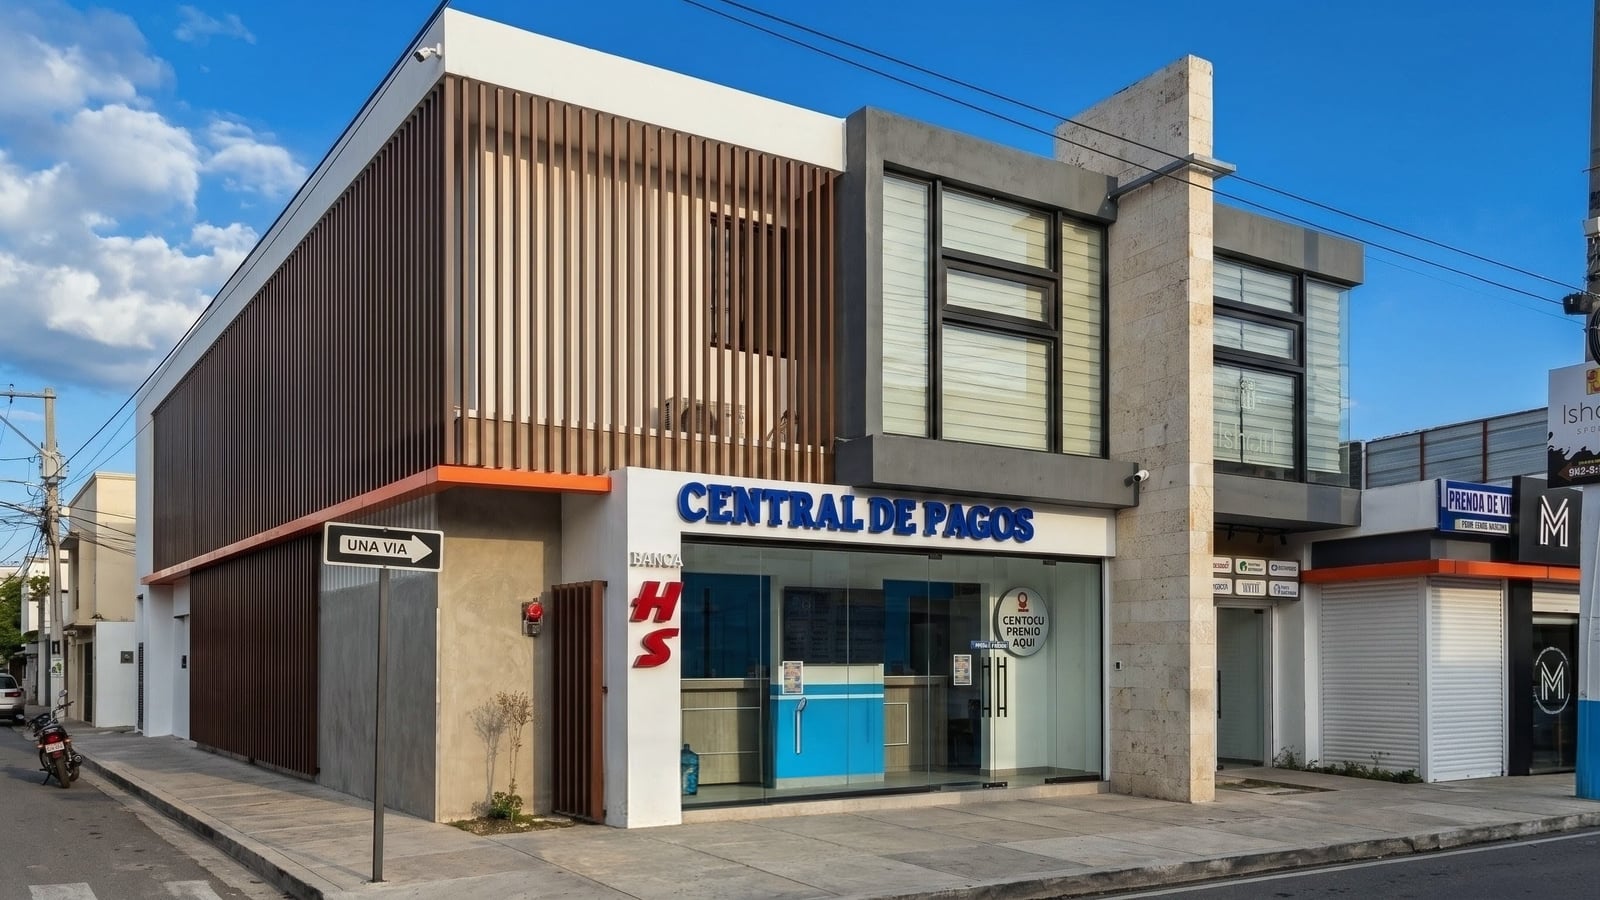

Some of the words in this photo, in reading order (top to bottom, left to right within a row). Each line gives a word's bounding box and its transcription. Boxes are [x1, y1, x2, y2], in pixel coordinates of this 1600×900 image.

[677, 482, 864, 532] CENTRAL
[868, 496, 917, 536] DE
[923, 502, 1035, 544] PAGOS
[1487, 494, 1499, 515] DE
[1540, 495, 1568, 547] M
[347, 539, 379, 553] UNA
[383, 542, 407, 555] VIA
[629, 551, 684, 568] BANCA
[1012, 638, 1035, 649] AQUI
